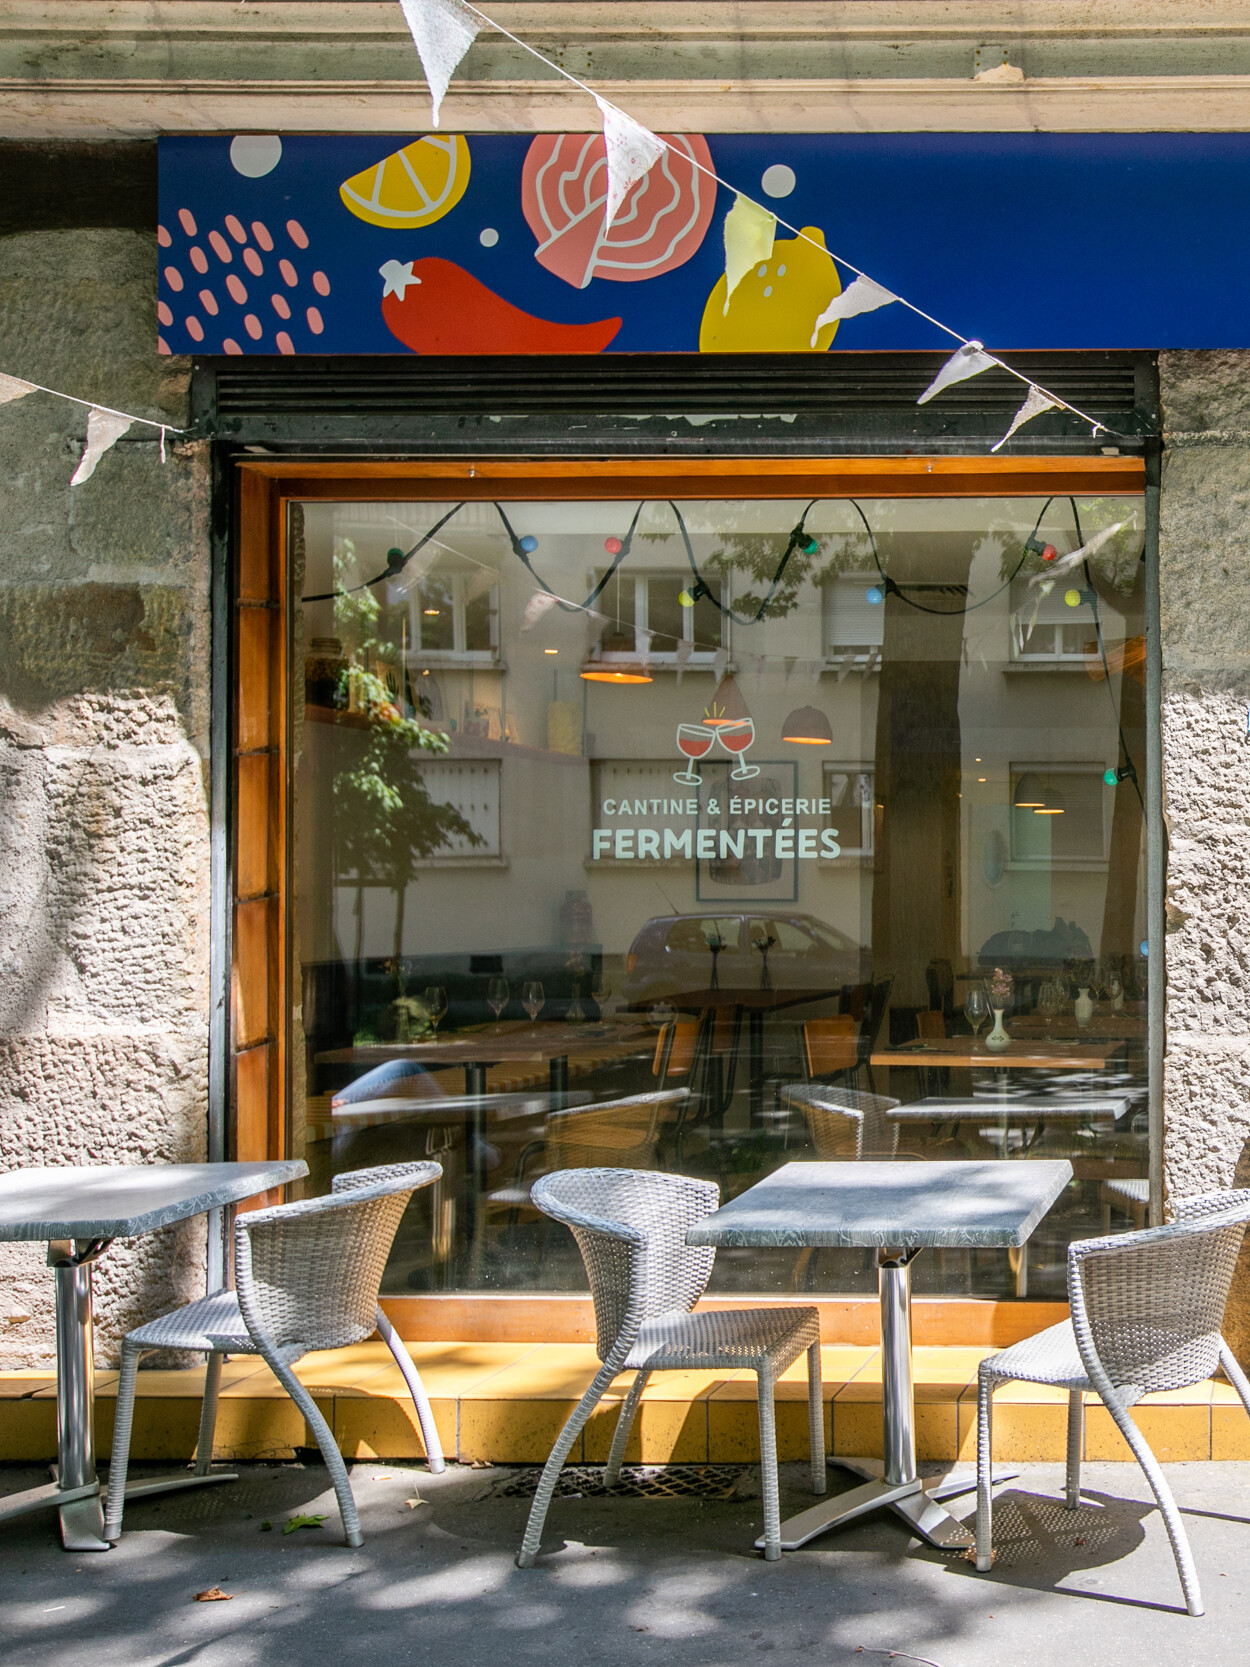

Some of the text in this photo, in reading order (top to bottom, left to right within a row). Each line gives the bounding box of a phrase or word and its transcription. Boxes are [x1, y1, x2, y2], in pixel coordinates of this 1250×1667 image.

[603, 795, 831, 815] CANTINE & ÉPICERIE
[593, 818, 841, 860] FERMENTÉES
